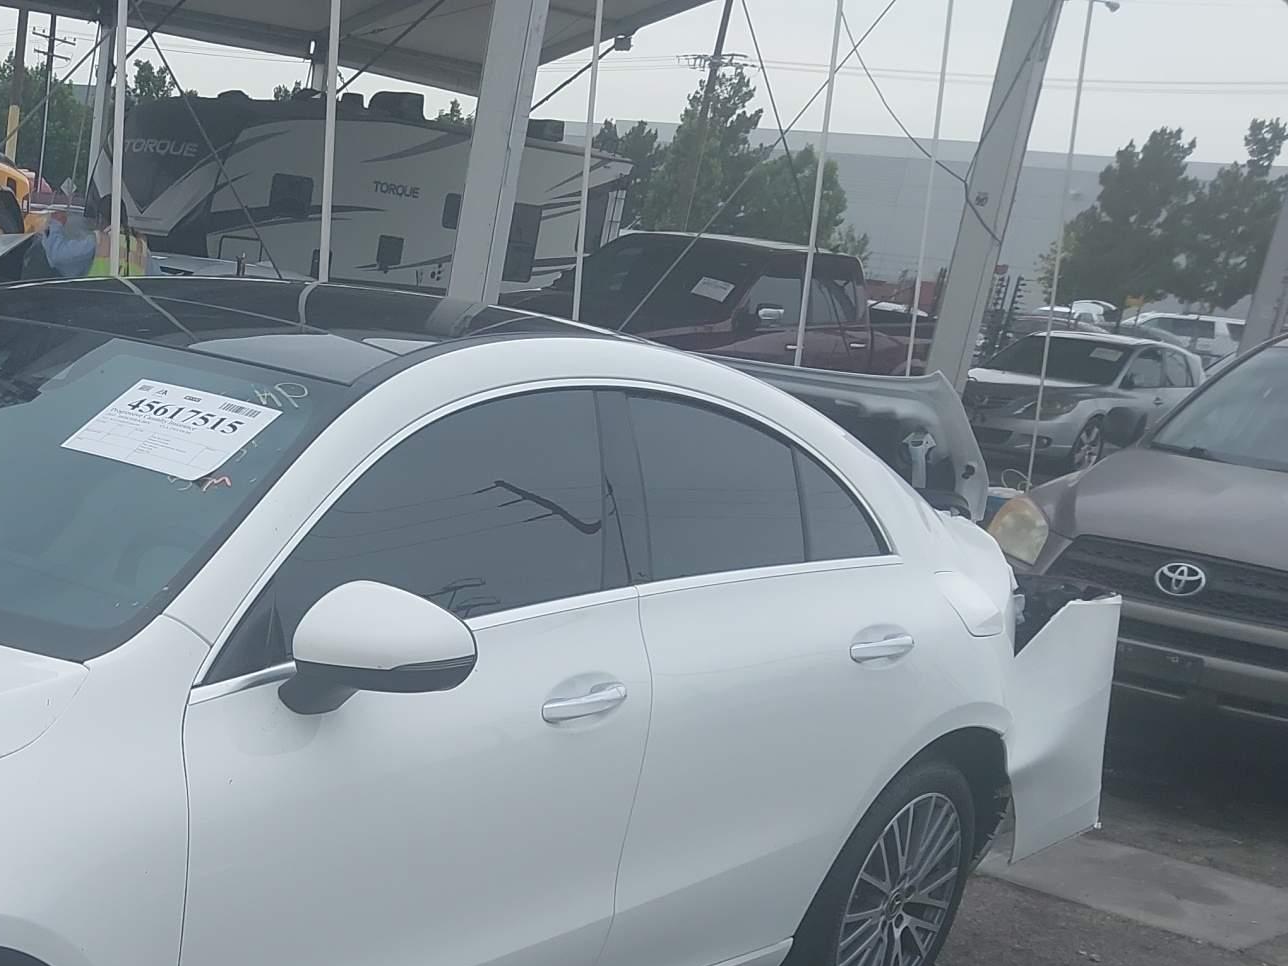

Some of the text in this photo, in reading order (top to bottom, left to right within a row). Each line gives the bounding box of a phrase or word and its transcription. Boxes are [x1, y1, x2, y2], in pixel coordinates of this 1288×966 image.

[124, 138, 199, 158] TORQUE
[373, 180, 421, 199] TORQUE
[127, 397, 245, 435] 45617515
